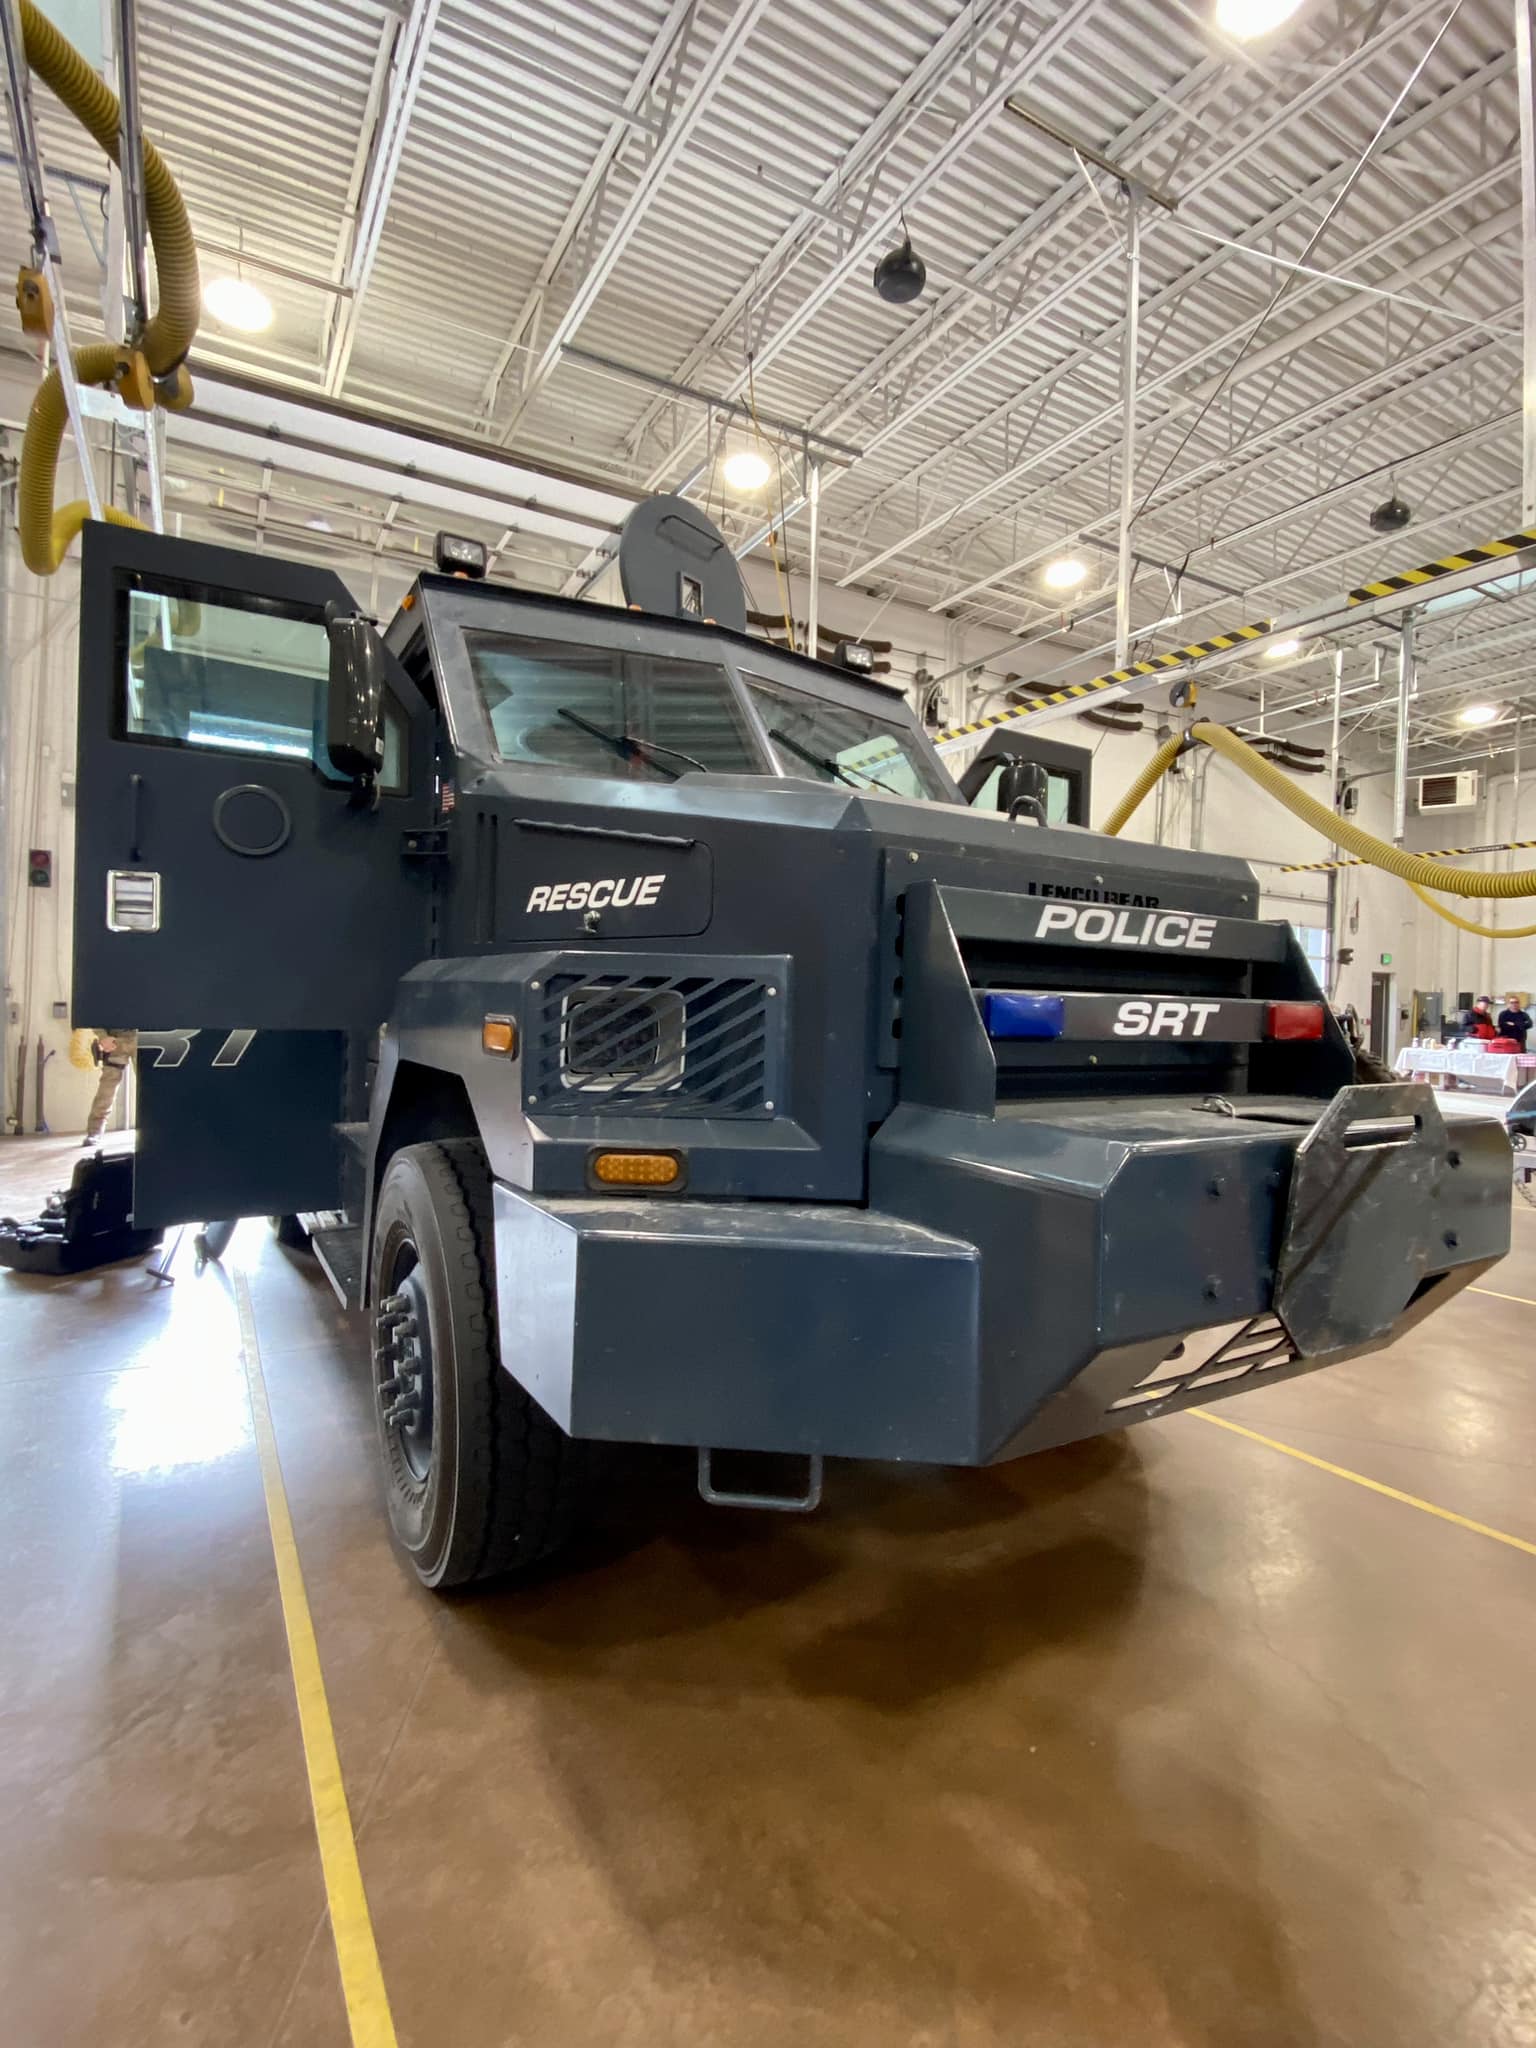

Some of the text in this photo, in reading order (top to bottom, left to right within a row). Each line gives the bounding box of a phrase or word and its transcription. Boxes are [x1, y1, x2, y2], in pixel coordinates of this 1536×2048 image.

[526, 874, 666, 913] RESCUE
[1028, 882, 1160, 909] LENCO BEAR
[1034, 904, 1218, 950] POLICE
[1112, 1001, 1220, 1037] SRT
